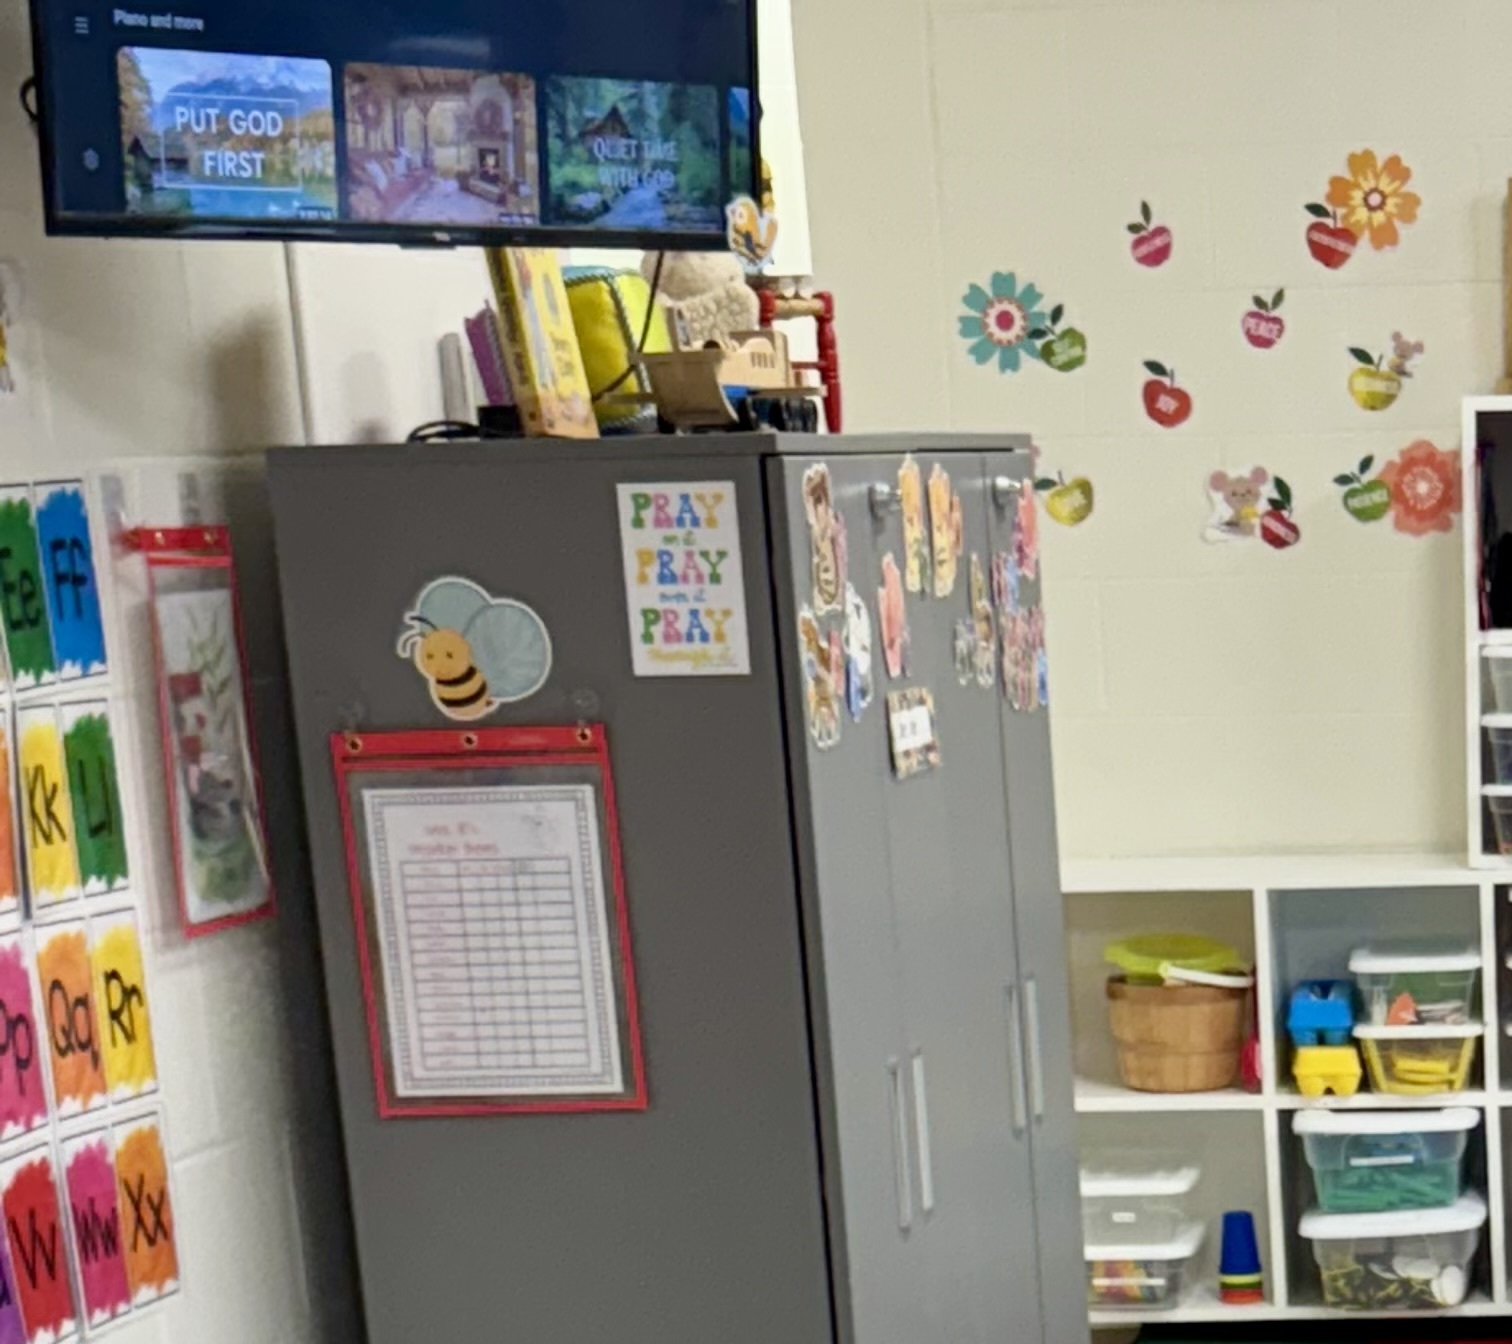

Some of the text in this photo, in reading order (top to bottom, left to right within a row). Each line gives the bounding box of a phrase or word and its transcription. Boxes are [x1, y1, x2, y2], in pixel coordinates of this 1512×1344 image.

[175, 106, 284, 137] PUT GOD
[204, 150, 265, 178] FIRST
[630, 492, 725, 529] PRAY
[50, 536, 88, 621] Ff
[635, 549, 729, 585] PRAY
[640, 608, 733, 644] PRAY
[26, 764, 67, 848] Kk
[50, 979, 100, 1071] Qq
[104, 969, 144, 1047] Rr
[123, 1173, 169, 1252] Xx
